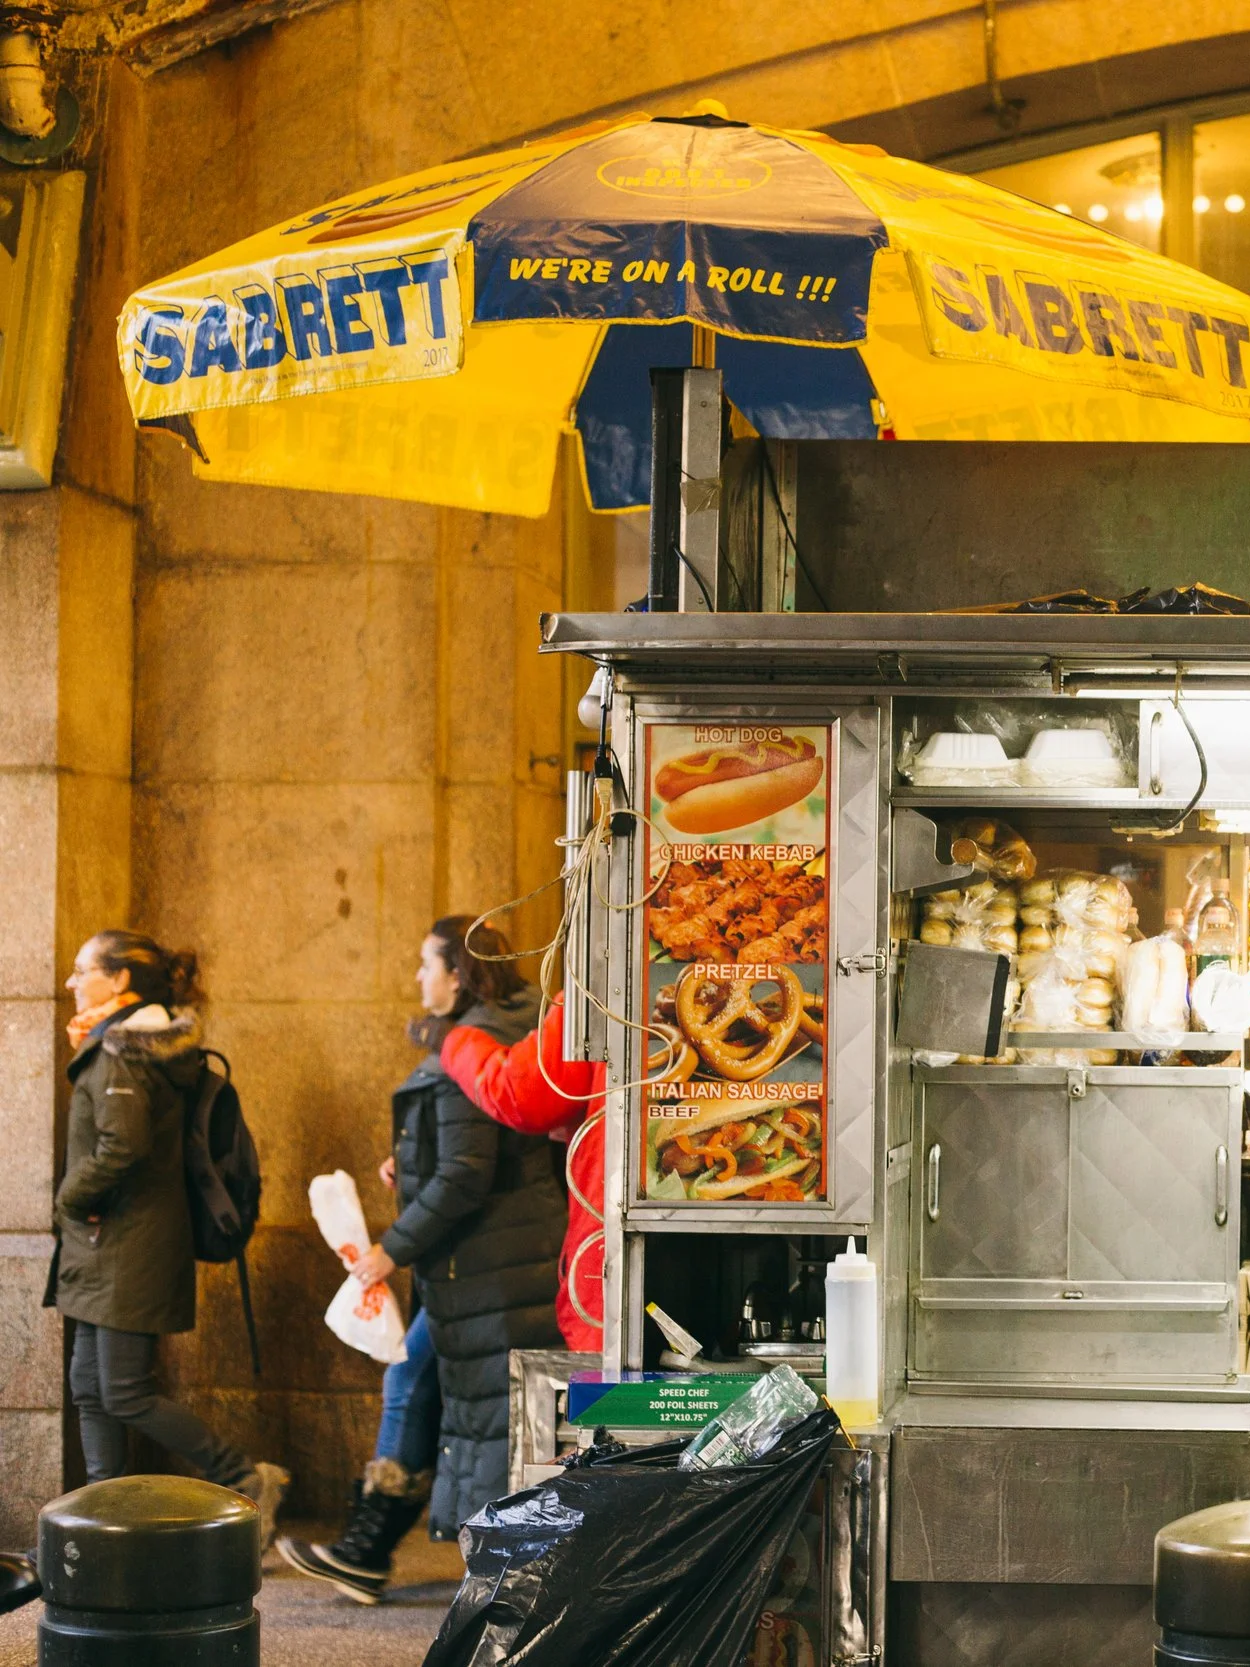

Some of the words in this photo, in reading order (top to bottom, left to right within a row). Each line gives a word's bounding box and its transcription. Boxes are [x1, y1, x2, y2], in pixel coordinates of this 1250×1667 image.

[509, 258, 612, 284] WE'RE
[622, 260, 670, 283] ON
[677, 260, 695, 282] A
[707, 266, 785, 296] ROLL
[796, 275, 837, 302] !!!
[134, 248, 449, 385] SABRETT
[923, 252, 1250, 389] SABRETT
[423, 347, 448, 367] 2017
[695, 727, 736, 743] HOT
[740, 727, 783, 743] DOG
[660, 844, 744, 861] CHICKEN
[750, 844, 816, 861] KEBAB
[694, 963, 779, 980] PRETZEL
[651, 1083, 722, 1099] ITALIAN
[727, 1083, 819, 1099] SAUSAGE
[649, 1106, 699, 1118] BEEF
[659, 1388, 686, 1397] SPEED
[688, 1388, 710, 1397] CHEF
[649, 1401, 665, 1409] 200
[667, 1401, 686, 1409] FOIL
[688, 1401, 719, 1409] SHEETS
[660, 1413, 708, 1421] 12"X10.75"
